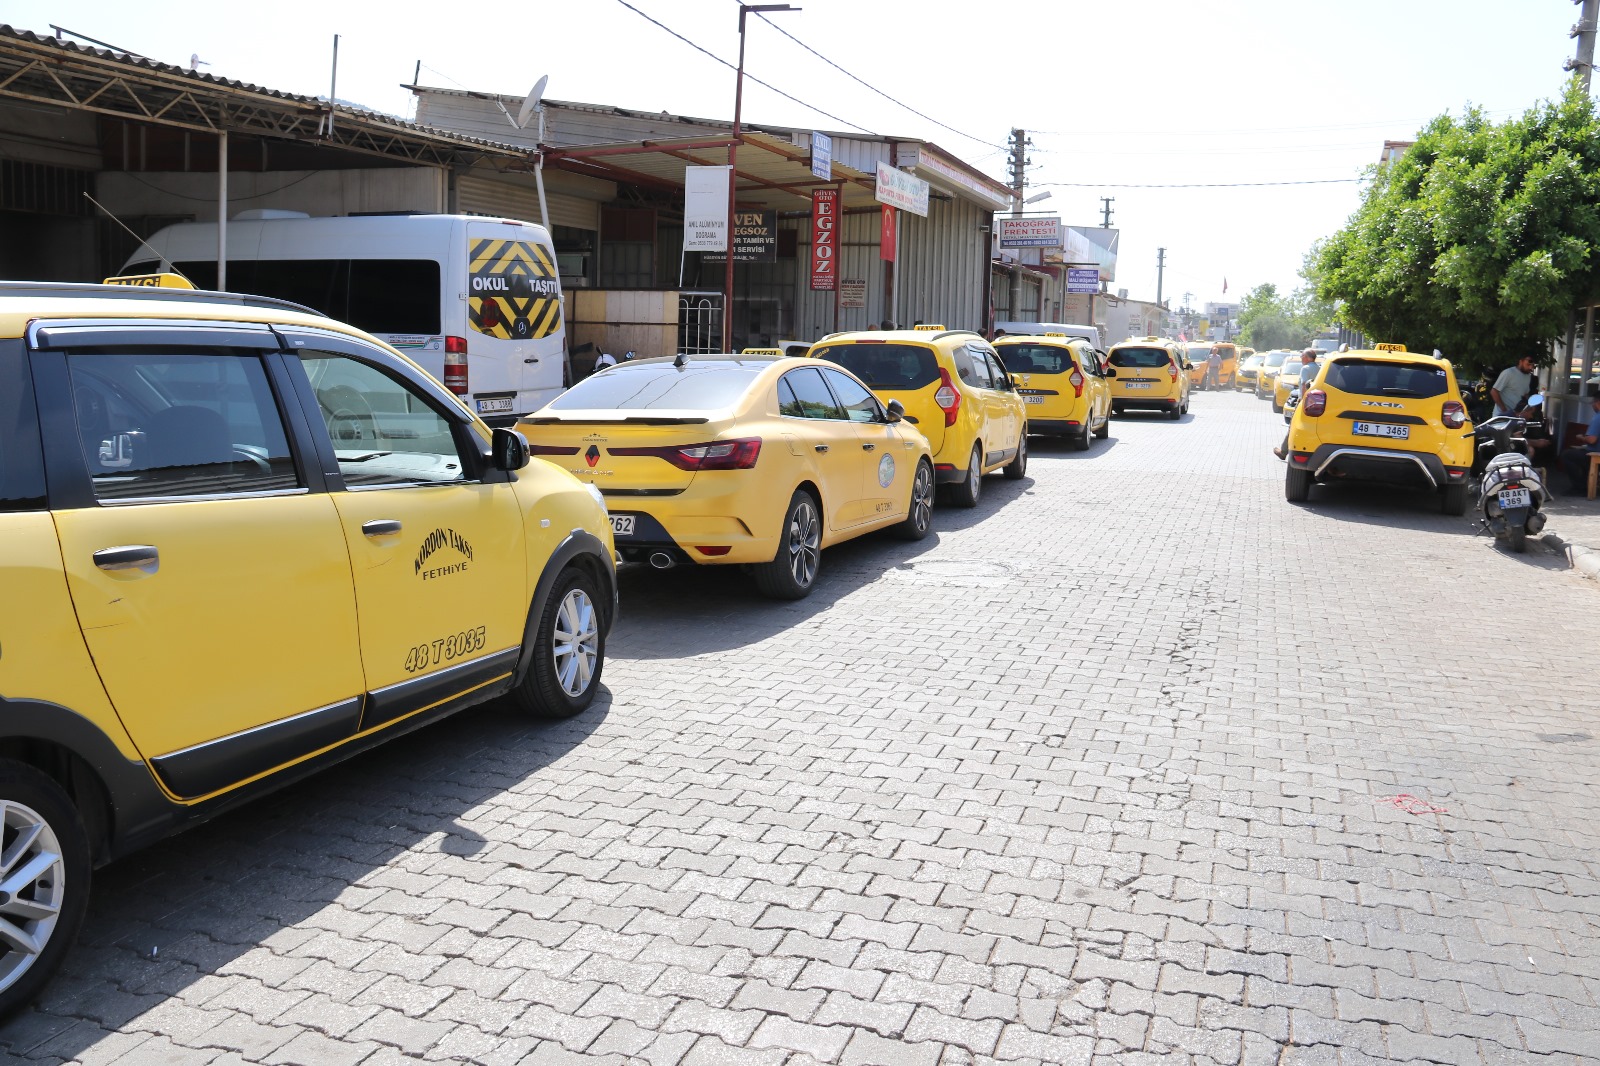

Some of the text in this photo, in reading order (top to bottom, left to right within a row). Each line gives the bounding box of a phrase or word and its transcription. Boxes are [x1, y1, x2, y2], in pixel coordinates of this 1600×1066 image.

[1031, 226, 1056, 235] TESTİ
[816, 202, 833, 273] EGZOZ
[737, 245, 765, 253] SERVİSİ
[472, 277, 558, 296] OKUL TAŞITI
[1361, 400, 1404, 408] DACIA
[1358, 423, 1408, 436] 48 T 3465
[1500, 489, 1527, 498] 48 AKT
[1506, 497, 1522, 506] 369
[414, 528, 448, 576] KORDON
[404, 625, 486, 673] 48 T 3035
